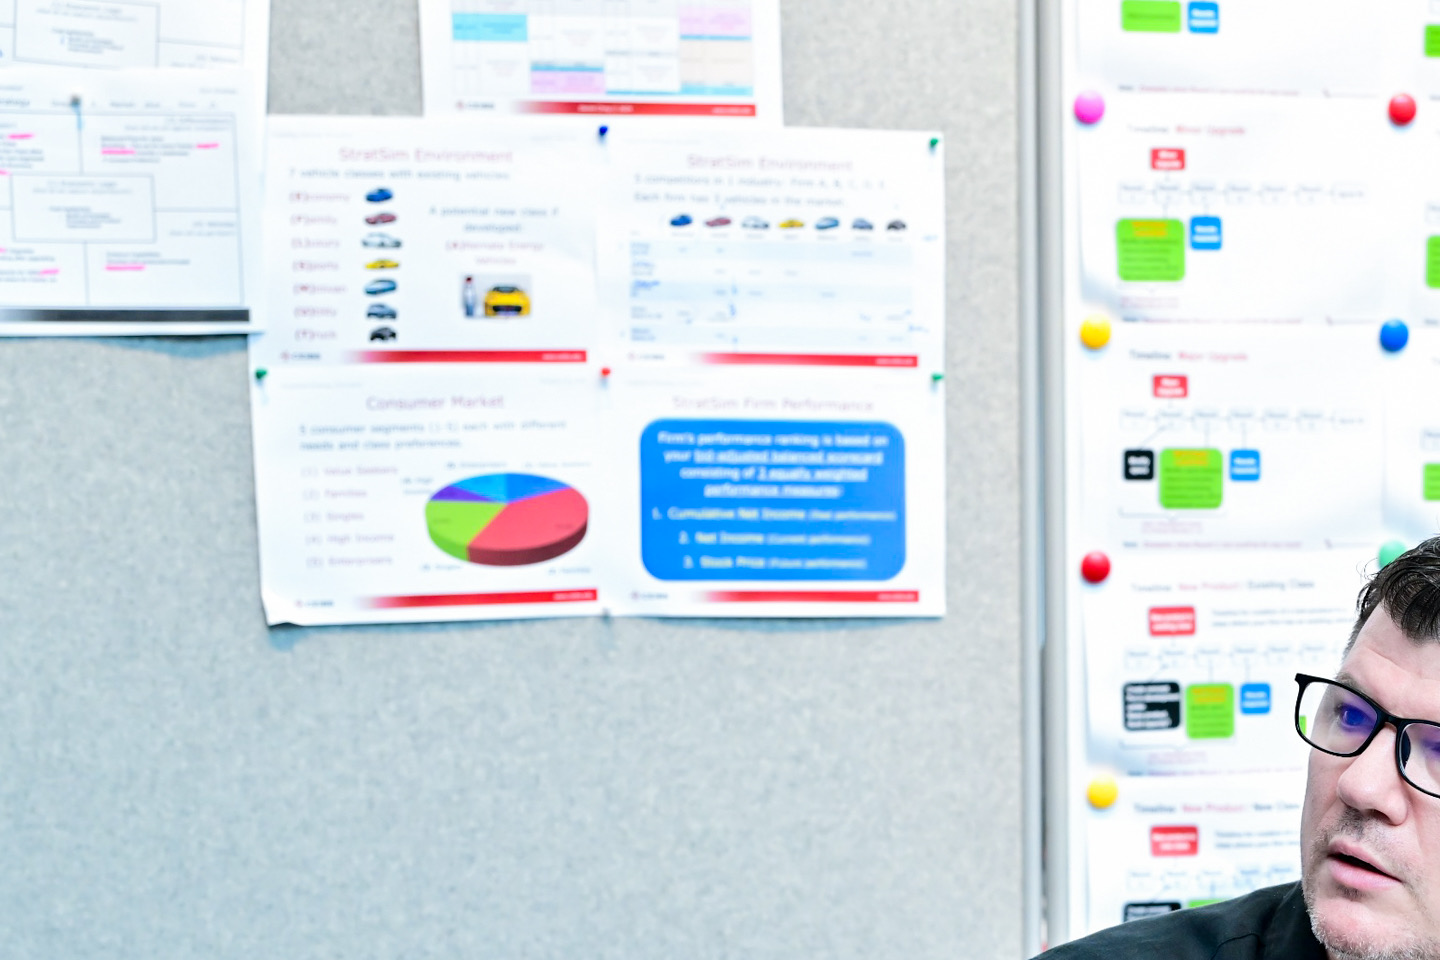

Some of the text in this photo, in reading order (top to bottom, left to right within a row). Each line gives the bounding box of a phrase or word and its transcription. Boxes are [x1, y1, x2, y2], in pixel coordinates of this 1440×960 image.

[339, 148, 513, 163] StratSim Environment
[759, 157, 853, 171] Environment
[390, 169, 411, 179] with
[366, 396, 504, 410] Consumer Market
[698, 432, 771, 447] performance
[836, 434, 869, 447] based
[704, 482, 778, 498] performance
[668, 507, 734, 520] Cumulative
[739, 508, 758, 520] Net
[762, 508, 804, 520] Income
[696, 532, 717, 544] Net
[721, 532, 763, 544] Income
